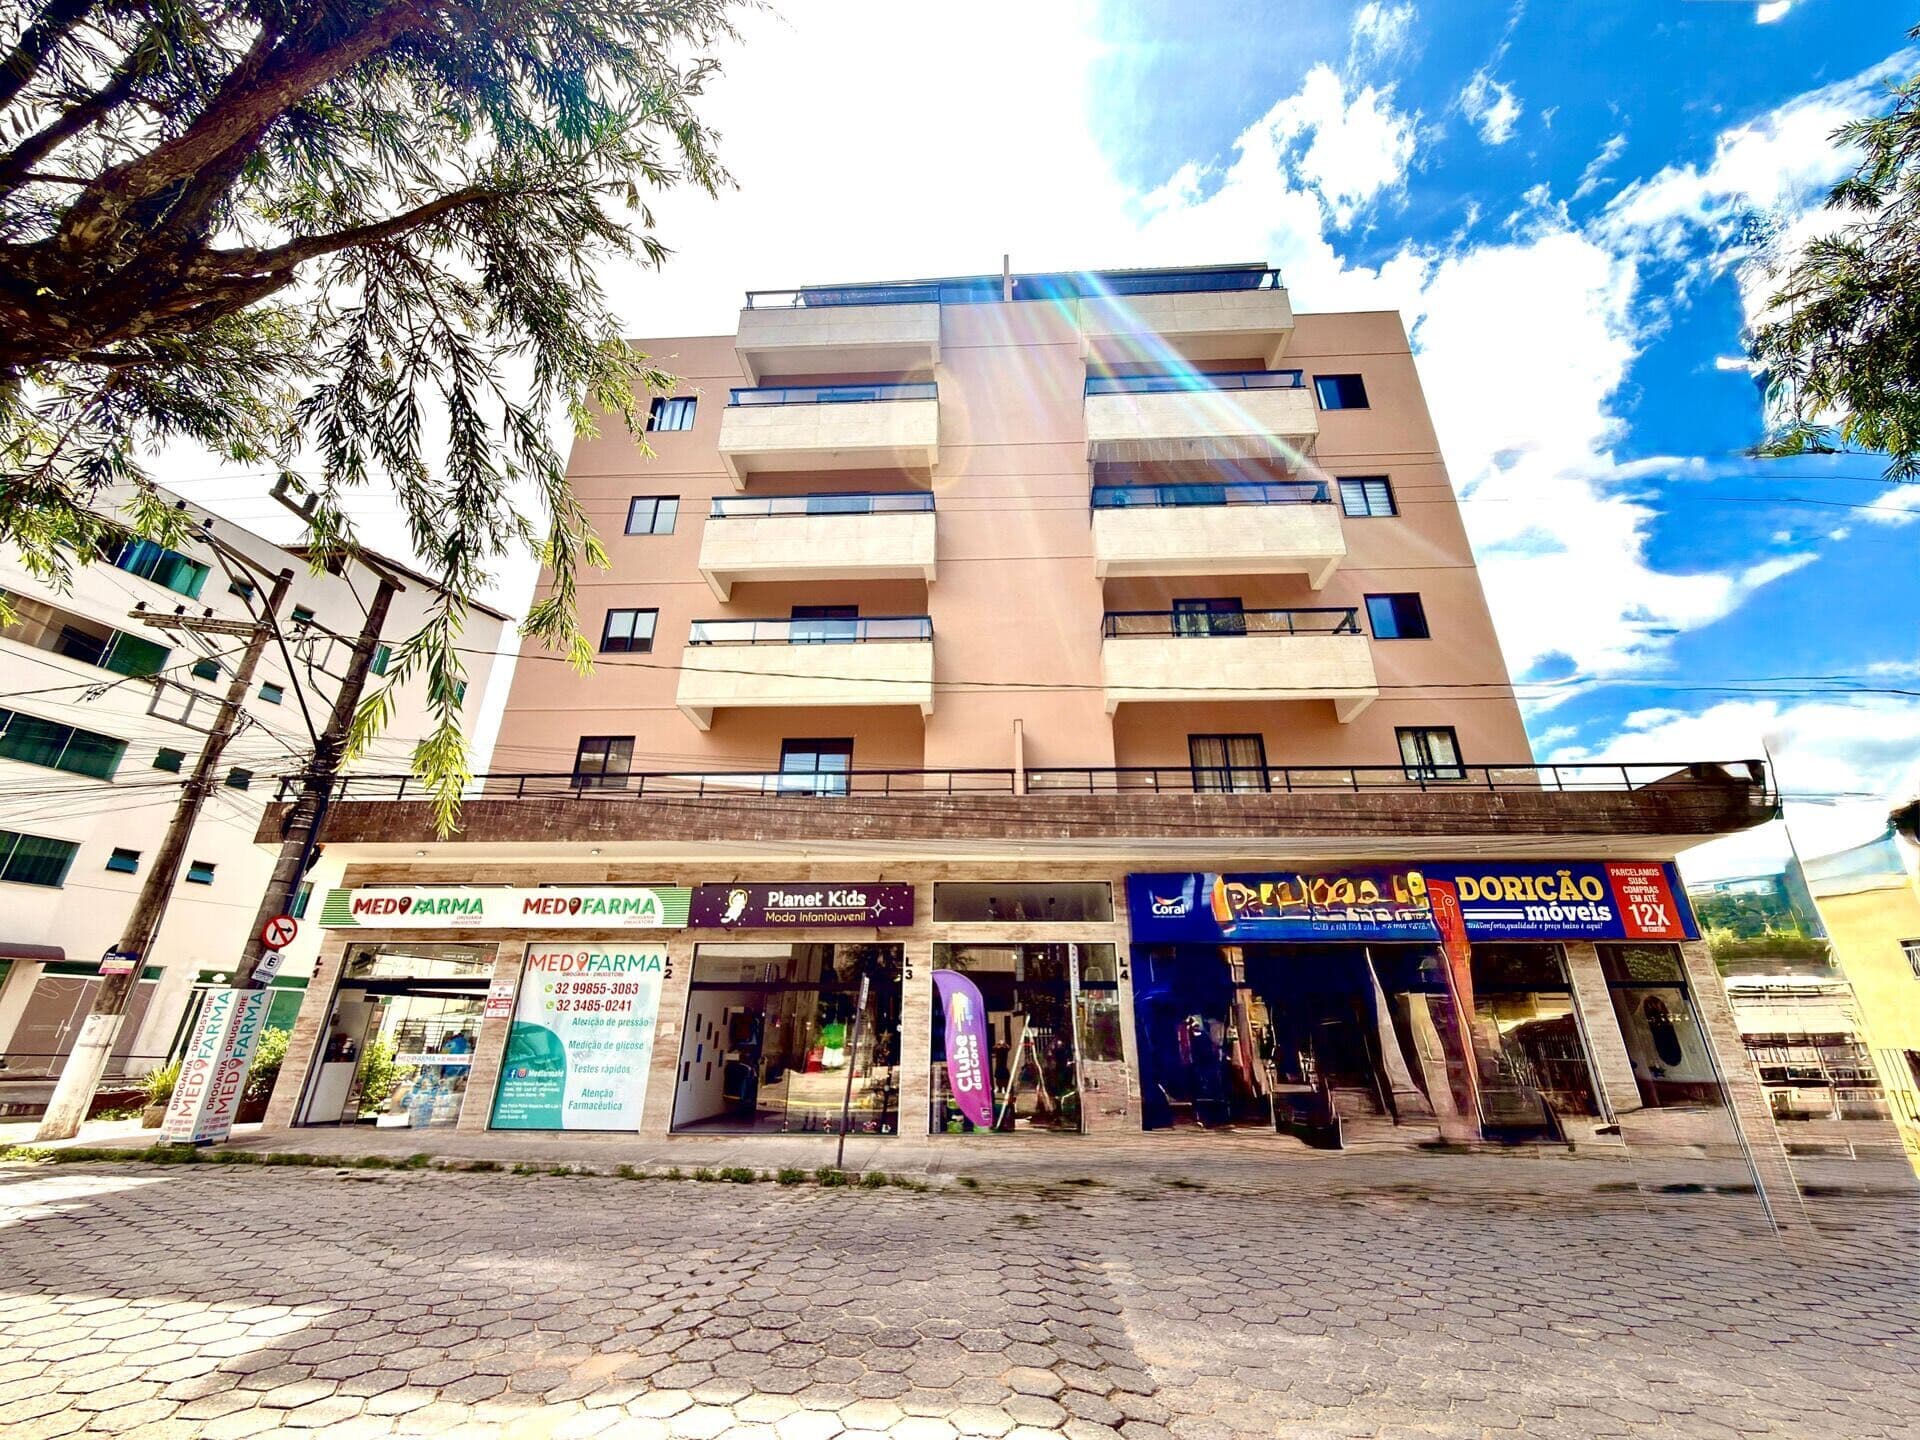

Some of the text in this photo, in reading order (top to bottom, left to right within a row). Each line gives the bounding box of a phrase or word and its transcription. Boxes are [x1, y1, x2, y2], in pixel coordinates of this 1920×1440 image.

[1611, 868, 1660, 877] PARCELAMOS
[1628, 877, 1649, 885] SUAS
[1623, 886, 1660, 894] COMPRAS
[768, 890, 867, 907] Planet Kids
[1630, 895, 1643, 903] EM
[1152, 904, 1186, 915] Coral
[1525, 901, 1613, 922] móveis
[765, 911, 866, 922] Moda Infantojuvenil
[1628, 904, 1672, 926] 12X
[267, 957, 277, 967] E
[665, 956, 673, 967] L
[906, 957, 914, 967] L
[1119, 957, 1128, 967] L
[664, 969, 673, 979] 2
[905, 970, 913, 980] 3
[1120, 970, 1129, 980] 4
[555, 983, 639, 995] 32 99855-3083
[556, 1000, 633, 1012] 32 3485-0241
[606, 1017, 616, 1027] de
[618, 1017, 649, 1029] pressão
[568, 1041, 644, 1052] Medição de glicose
[956, 1035, 973, 1092] Clube
[574, 1064, 599, 1074] Testes
[581, 1088, 614, 1099] Atenção
[568, 1101, 623, 1111] Farmacêutica
